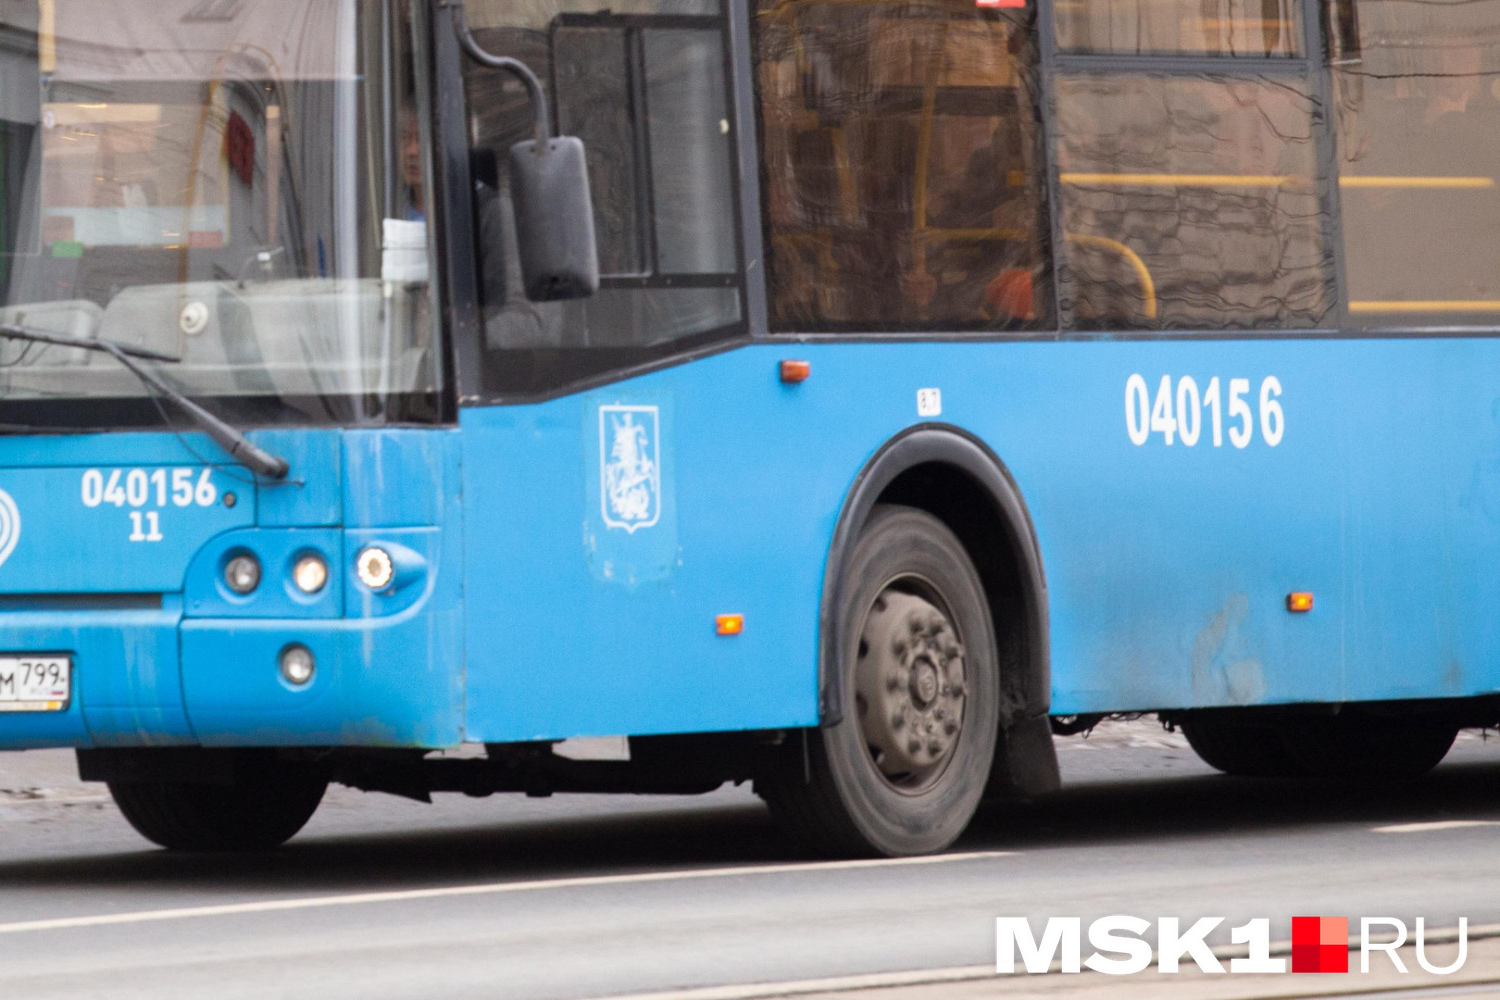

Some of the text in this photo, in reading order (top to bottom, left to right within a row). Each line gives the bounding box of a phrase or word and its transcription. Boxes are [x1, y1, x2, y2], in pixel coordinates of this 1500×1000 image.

[1125, 373, 1285, 450] 040156
[81, 468, 217, 507] 040156
[128, 511, 163, 541] 11
